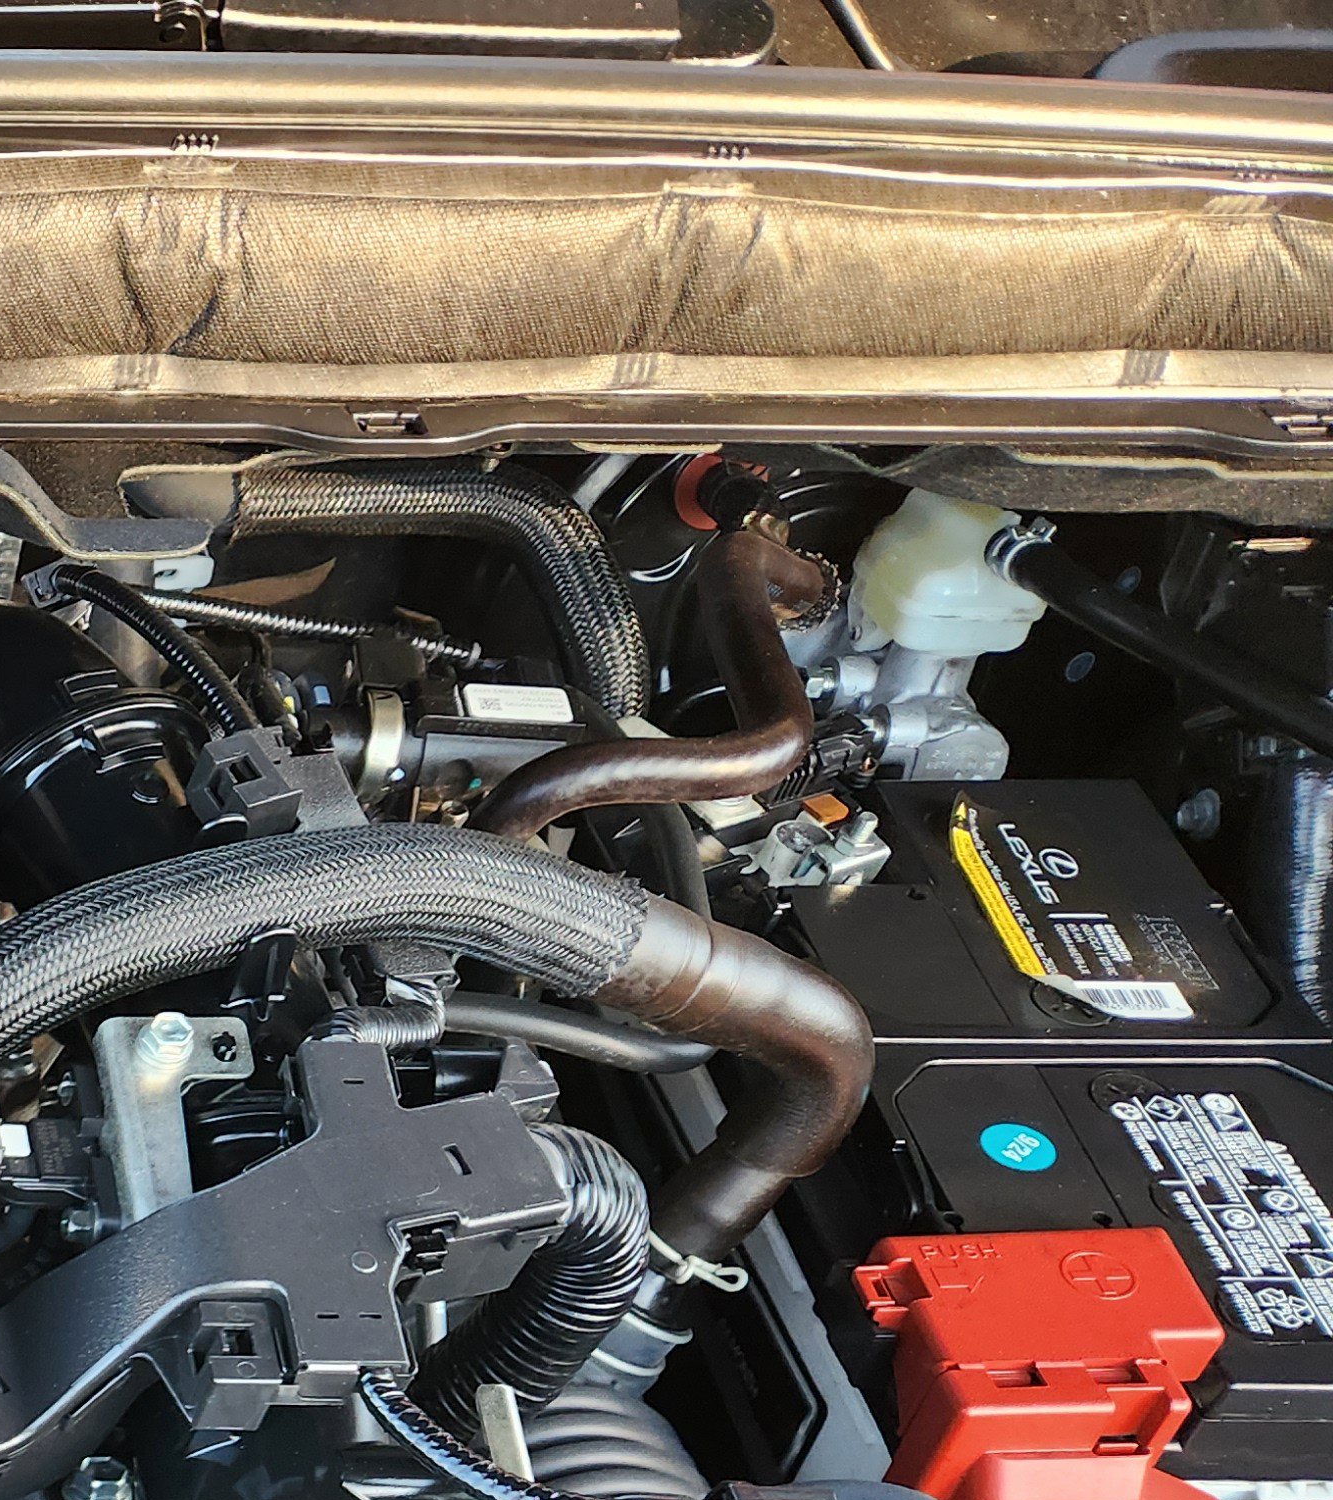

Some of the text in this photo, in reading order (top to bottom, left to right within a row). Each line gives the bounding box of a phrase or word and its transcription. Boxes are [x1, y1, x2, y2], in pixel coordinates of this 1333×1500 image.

[997, 823, 1060, 905] LEXUS
[1001, 1133, 1040, 1163] 9/24
[919, 1243, 1003, 1261] PUSH
